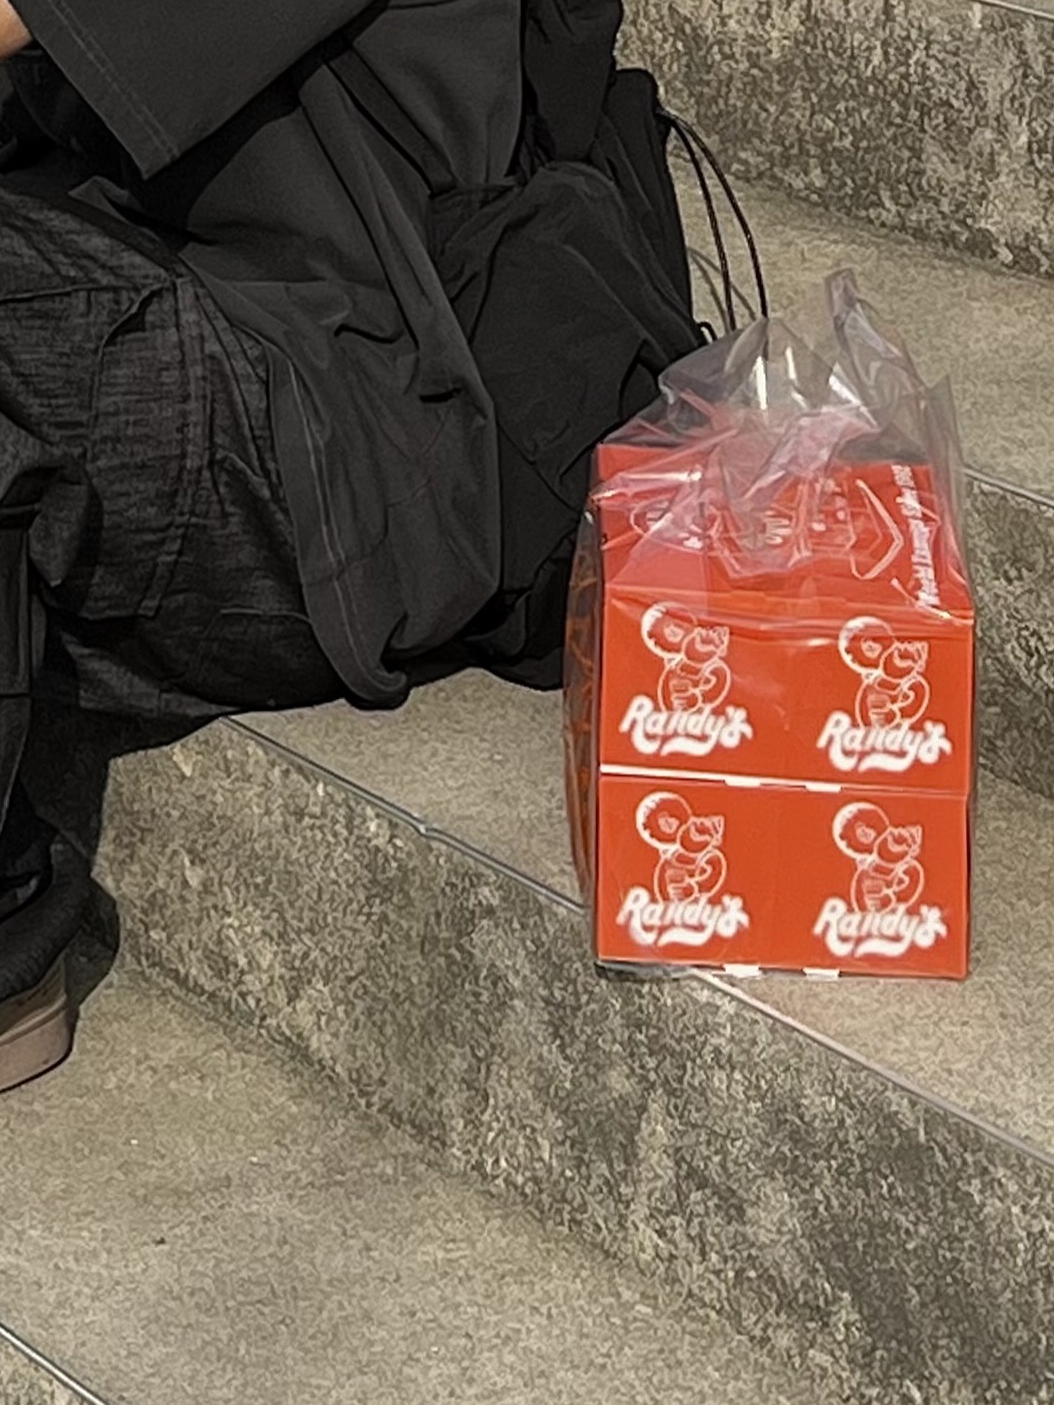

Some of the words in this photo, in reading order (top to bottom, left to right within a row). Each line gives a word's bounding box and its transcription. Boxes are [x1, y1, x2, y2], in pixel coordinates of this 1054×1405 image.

[619, 694, 753, 757] Randy's
[816, 710, 952, 773] Randy's
[616, 886, 749, 947] Randy's
[813, 896, 948, 958] Randy's
